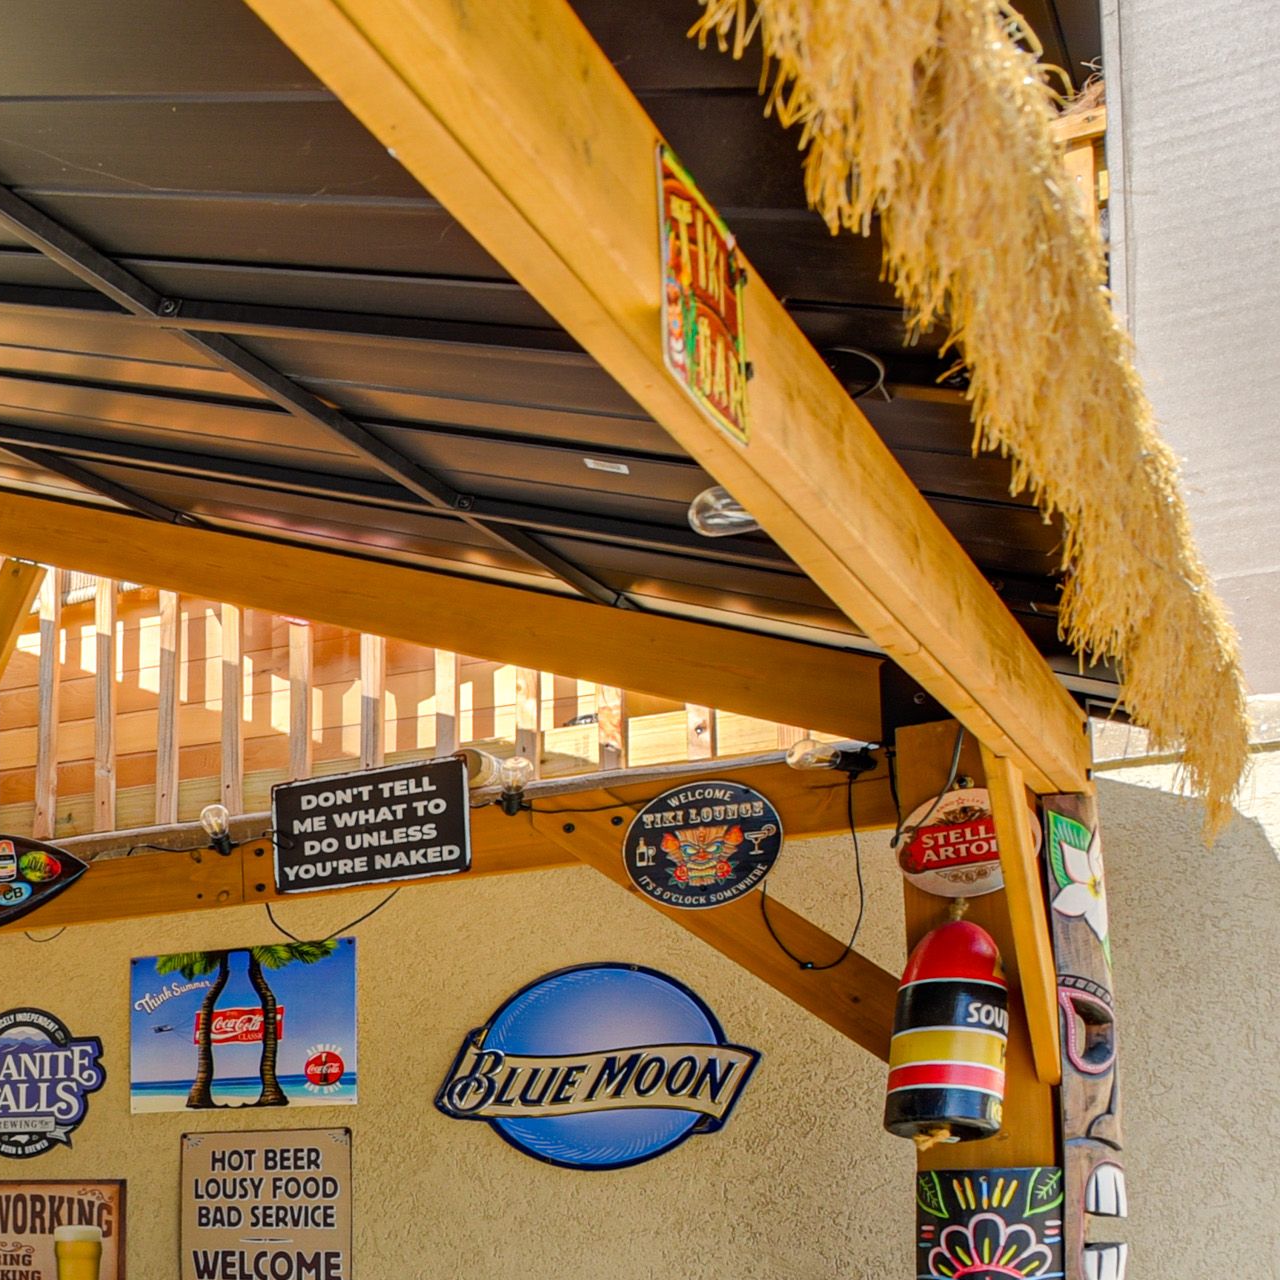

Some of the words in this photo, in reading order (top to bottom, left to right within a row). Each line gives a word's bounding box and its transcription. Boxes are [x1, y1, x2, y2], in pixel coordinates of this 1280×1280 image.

[300, 785, 374, 811] DON'T
[378, 776, 437, 799] TELL
[667, 788, 735, 808] WELCOME
[292, 816, 327, 834] ME
[332, 804, 407, 829] WHAT
[412, 798, 448, 817] TO
[642, 810, 684, 829] TIKI
[688, 801, 764, 823] LOUNGE
[304, 837, 339, 856] DO
[345, 823, 438, 850] UNLESS
[921, 825, 997, 848] STELL
[283, 856, 369, 882] YOU'RE
[374, 845, 461, 870] NAKED
[922, 840, 998, 864] ARTOI
[2, 886, 24, 901] CB
[638, 875, 656, 890] IT'S
[654, 887, 662, 896] 5
[663, 890, 707, 905] O'CLOCK
[709, 862, 768, 903] SOMEWHERE
[134, 987, 173, 1014] Think
[171, 980, 214, 998] Summer
[15, 1012, 60, 1034] INDEPENDENT
[446, 1049, 591, 1113] BLUE
[586, 1052, 740, 1105] MOON
[211, 1149, 256, 1171] HOT
[264, 1148, 321, 1170] BEER
[194, 1177, 264, 1200] LOUSY
[272, 1176, 339, 1199] FOOD
[198, 1206, 243, 1228] BAD
[250, 1205, 335, 1228] SERVICE
